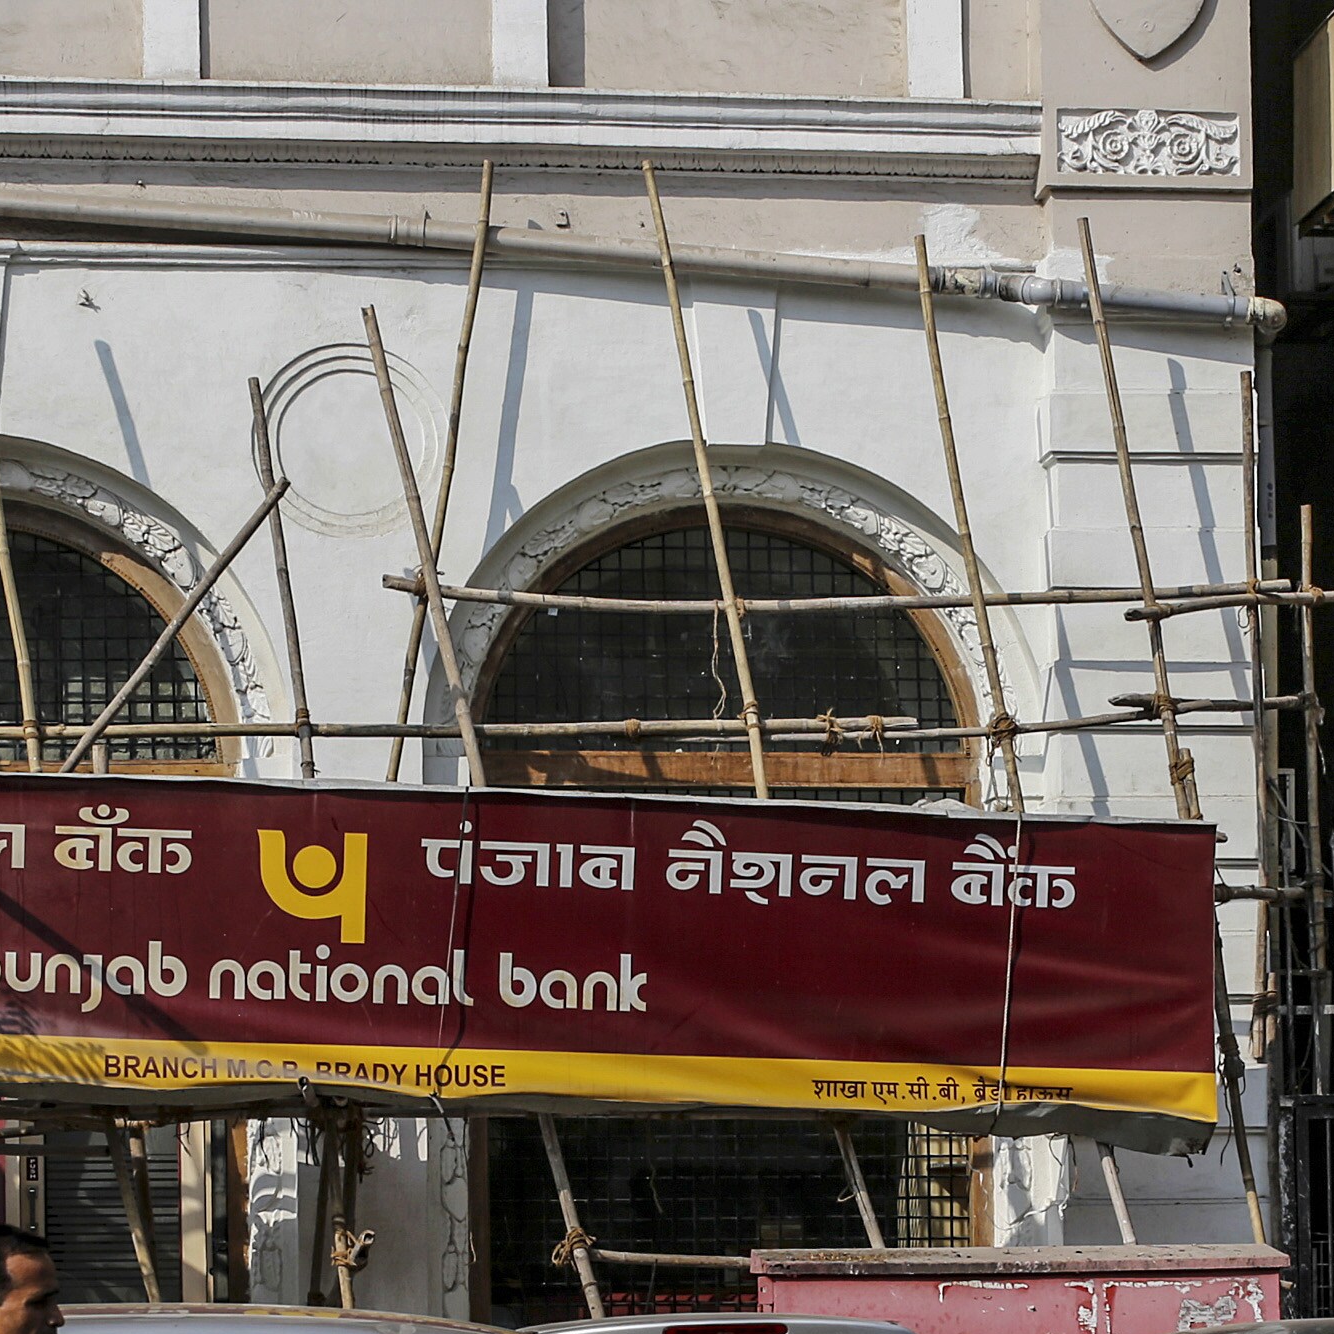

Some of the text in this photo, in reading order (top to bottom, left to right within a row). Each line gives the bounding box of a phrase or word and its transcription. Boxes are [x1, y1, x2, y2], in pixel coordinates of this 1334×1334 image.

[421, 819, 1077, 909] पंजाब नैशनल बैंक
[209, 944, 474, 1007] national
[499, 952, 648, 1012] bank
[104, 1055, 217, 1079] BRANCH
[315, 1061, 408, 1086] BRADY
[415, 1064, 506, 1088] HOUSE
[812, 1079, 867, 1099] शाखा
